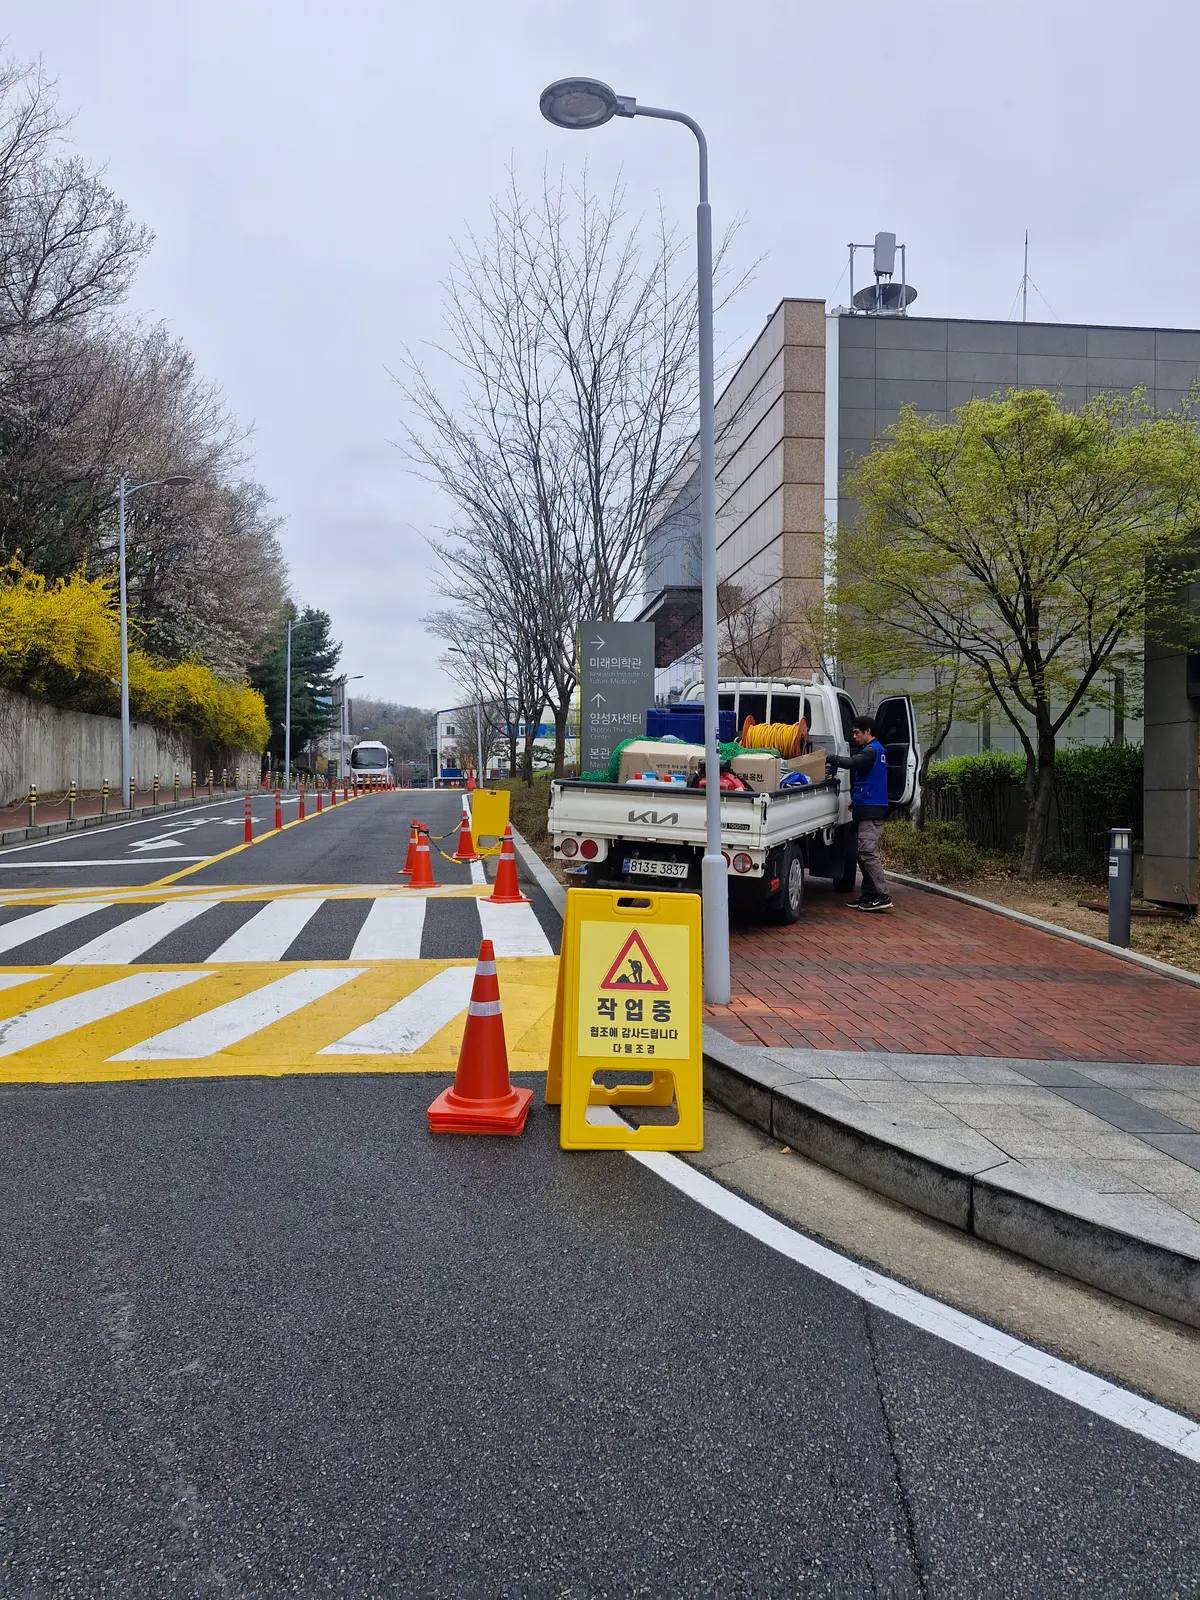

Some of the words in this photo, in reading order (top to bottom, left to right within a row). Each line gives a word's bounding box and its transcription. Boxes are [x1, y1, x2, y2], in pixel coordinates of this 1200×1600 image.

[589, 657, 642, 670] 미래의학관
[589, 712, 642, 725] 양성자센터
[589, 747, 611, 760] 본관
[628, 810, 679, 825] KIA
[659, 863, 686, 876] 3837
[590, 1026, 618, 1038] 협조에
[621, 1027, 679, 1040] 감사드립니다
